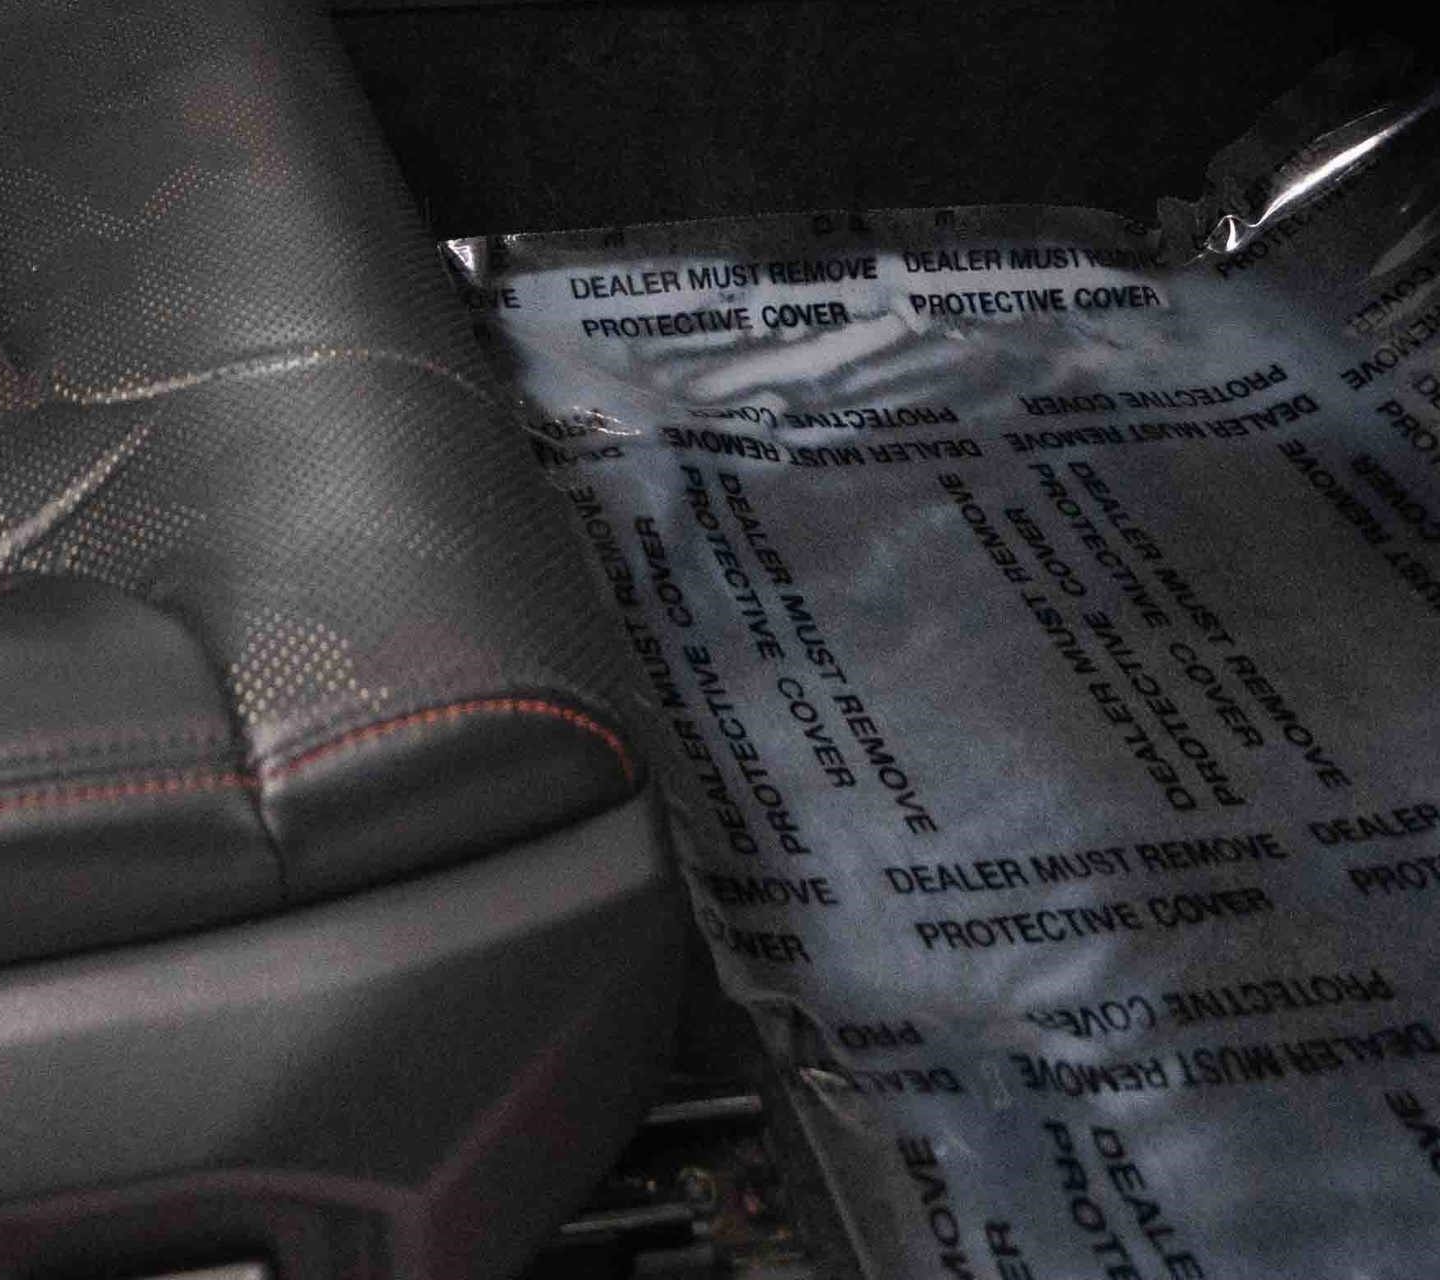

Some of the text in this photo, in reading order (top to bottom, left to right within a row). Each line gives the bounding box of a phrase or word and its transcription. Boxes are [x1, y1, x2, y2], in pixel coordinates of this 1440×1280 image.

[570, 254, 878, 300] DEALER MUST REMOVE
[903, 247, 1002, 273] DEALER
[1009, 246, 1082, 269] MUST
[580, 300, 852, 339] PROTECTIVE COVER
[910, 283, 1162, 318] PROTECTIVE COVER
[784, 405, 960, 431] PROTECTIVE
[1020, 363, 1288, 417] PROTECTIVE COVER
[661, 426, 984, 468] DEALER MUST REMOVE
[1002, 393, 1321, 454] DEALER MUST REMOVE
[1276, 438, 1391, 549] REMOVE
[568, 485, 645, 611] REMOVE
[679, 462, 858, 789] PROTECTIVE COVER
[1027, 461, 1267, 751] PROTECTIVE COVER
[1067, 460, 1354, 791] DEALER MUST REMOVE
[623, 614, 687, 712] MUST
[717, 470, 940, 836] DEALER MUST REMOVE
[936, 471, 1199, 814] DEALER MUST REMOVE
[1003, 505, 1247, 809] PROTECTIVE COVER
[633, 514, 809, 856] PROTECTIVE COVER
[670, 716, 761, 857] DEALER
[886, 831, 1290, 897] DEALER MUST REMOVE
[915, 886, 1277, 951] PROTECTIVE COVER
[1161, 968, 1396, 1028] PROTECTIVE
[1008, 1051, 1170, 1099] REMOVE
[1173, 1043, 1287, 1092] MUST
